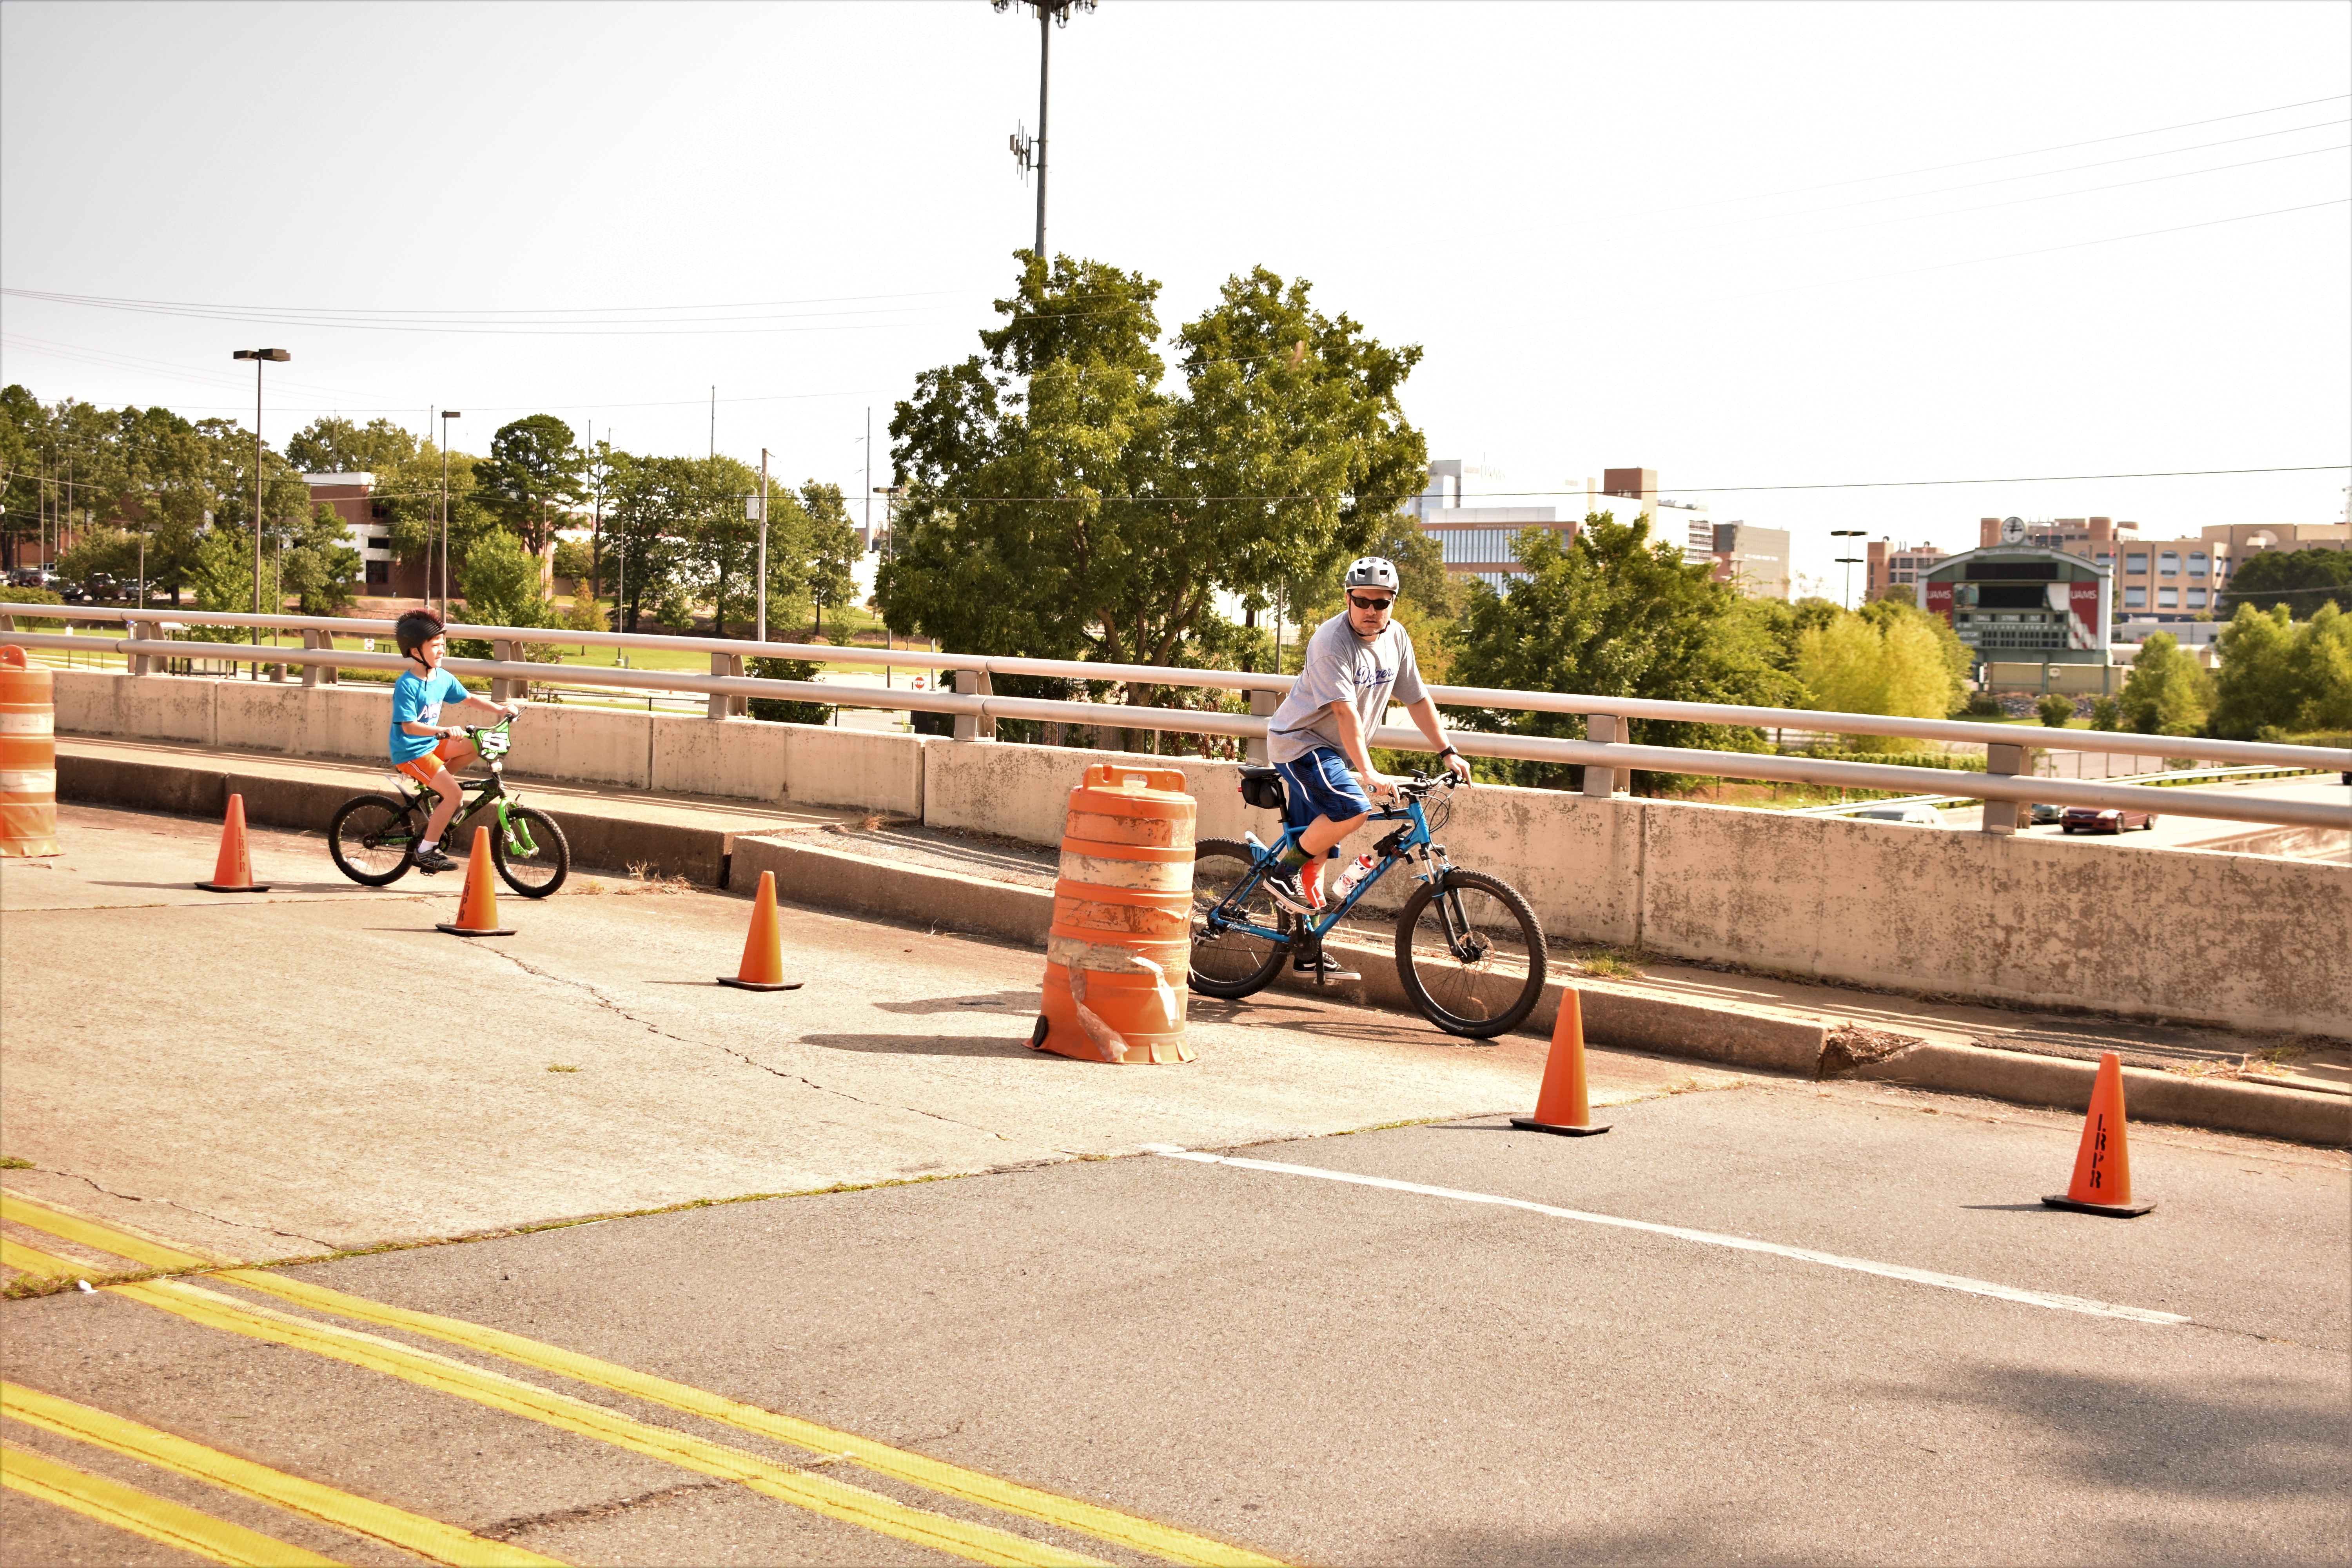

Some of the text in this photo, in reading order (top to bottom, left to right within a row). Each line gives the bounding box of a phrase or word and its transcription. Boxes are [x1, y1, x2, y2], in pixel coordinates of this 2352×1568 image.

[1927, 590, 1951, 599] UAMS
[2070, 590, 2097, 599] UAMS
[1354, 666, 1394, 689] Dodgers
